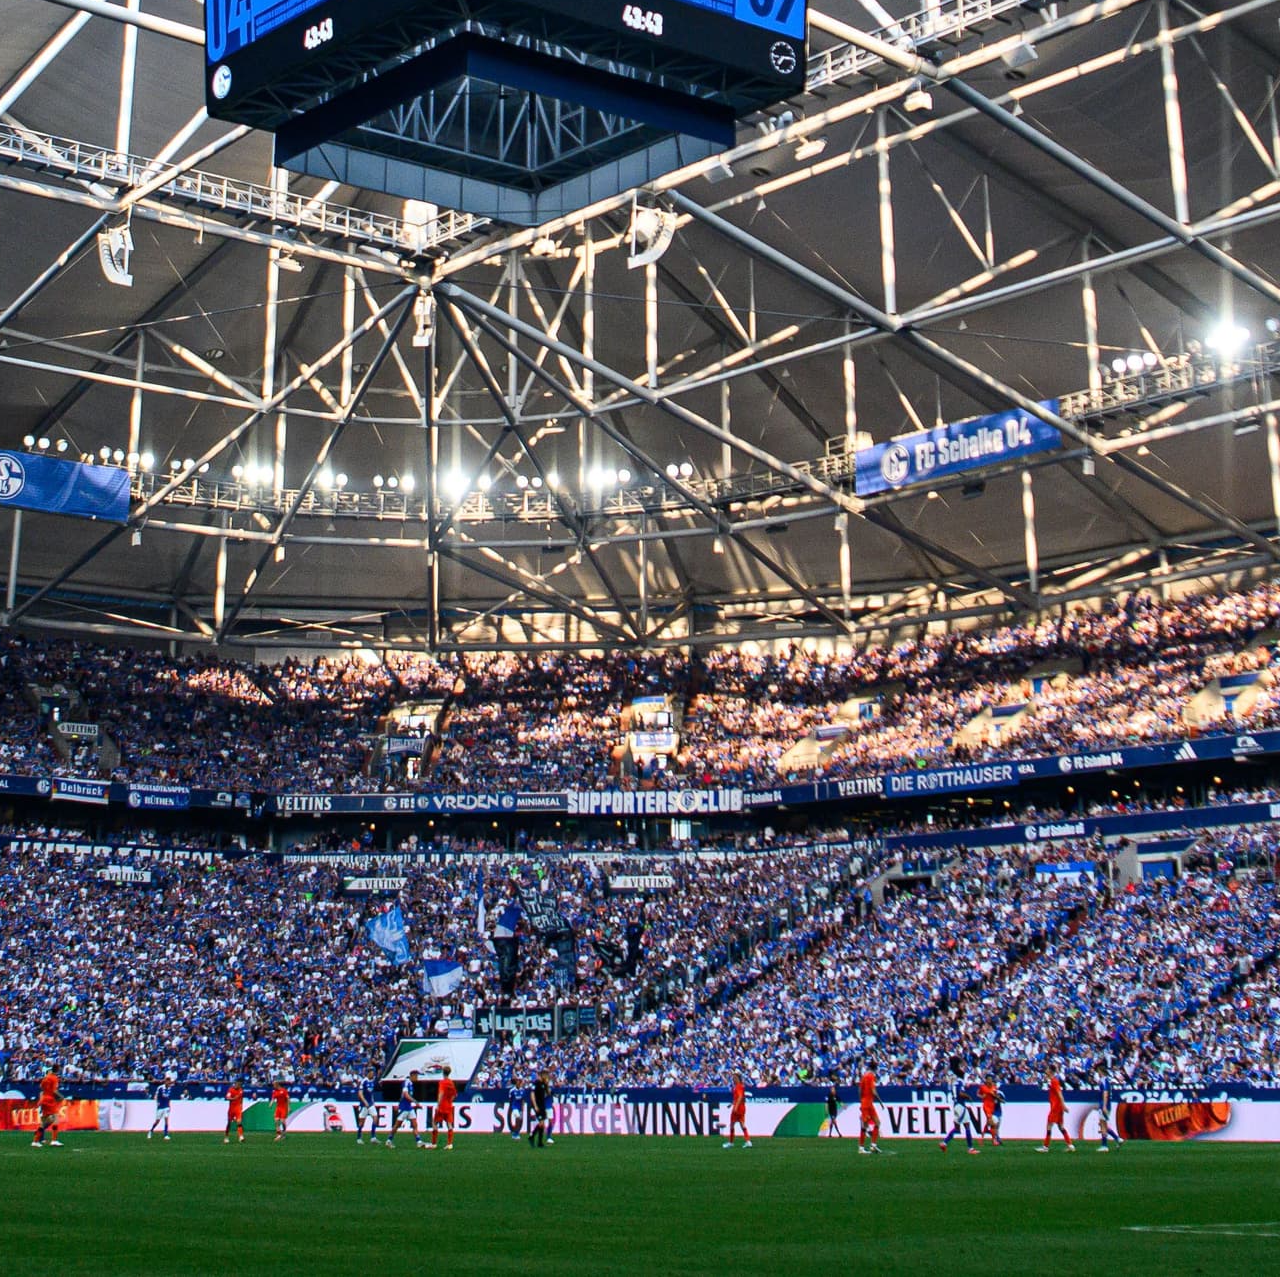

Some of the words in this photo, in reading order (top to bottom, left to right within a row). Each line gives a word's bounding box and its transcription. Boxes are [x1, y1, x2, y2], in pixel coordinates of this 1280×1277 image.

[914, 444, 937, 473] FC
[938, 426, 1004, 467] Schalke
[1006, 417, 1034, 447] 04
[66, 723, 97, 736] VELTINS
[891, 775, 914, 793] DIE
[917, 764, 1013, 791] ROTTHAUSER
[838, 778, 884, 796] VELTINS
[276, 795, 332, 811] VELTINS
[433, 793, 500, 810] VREDEN
[517, 796, 561, 807] MINIMEAL
[567, 790, 679, 814] SUPPORTERS
[697, 789, 743, 812] CLUB
[364, 878, 402, 890] VELTINS
[630, 877, 670, 890] VELTINS
